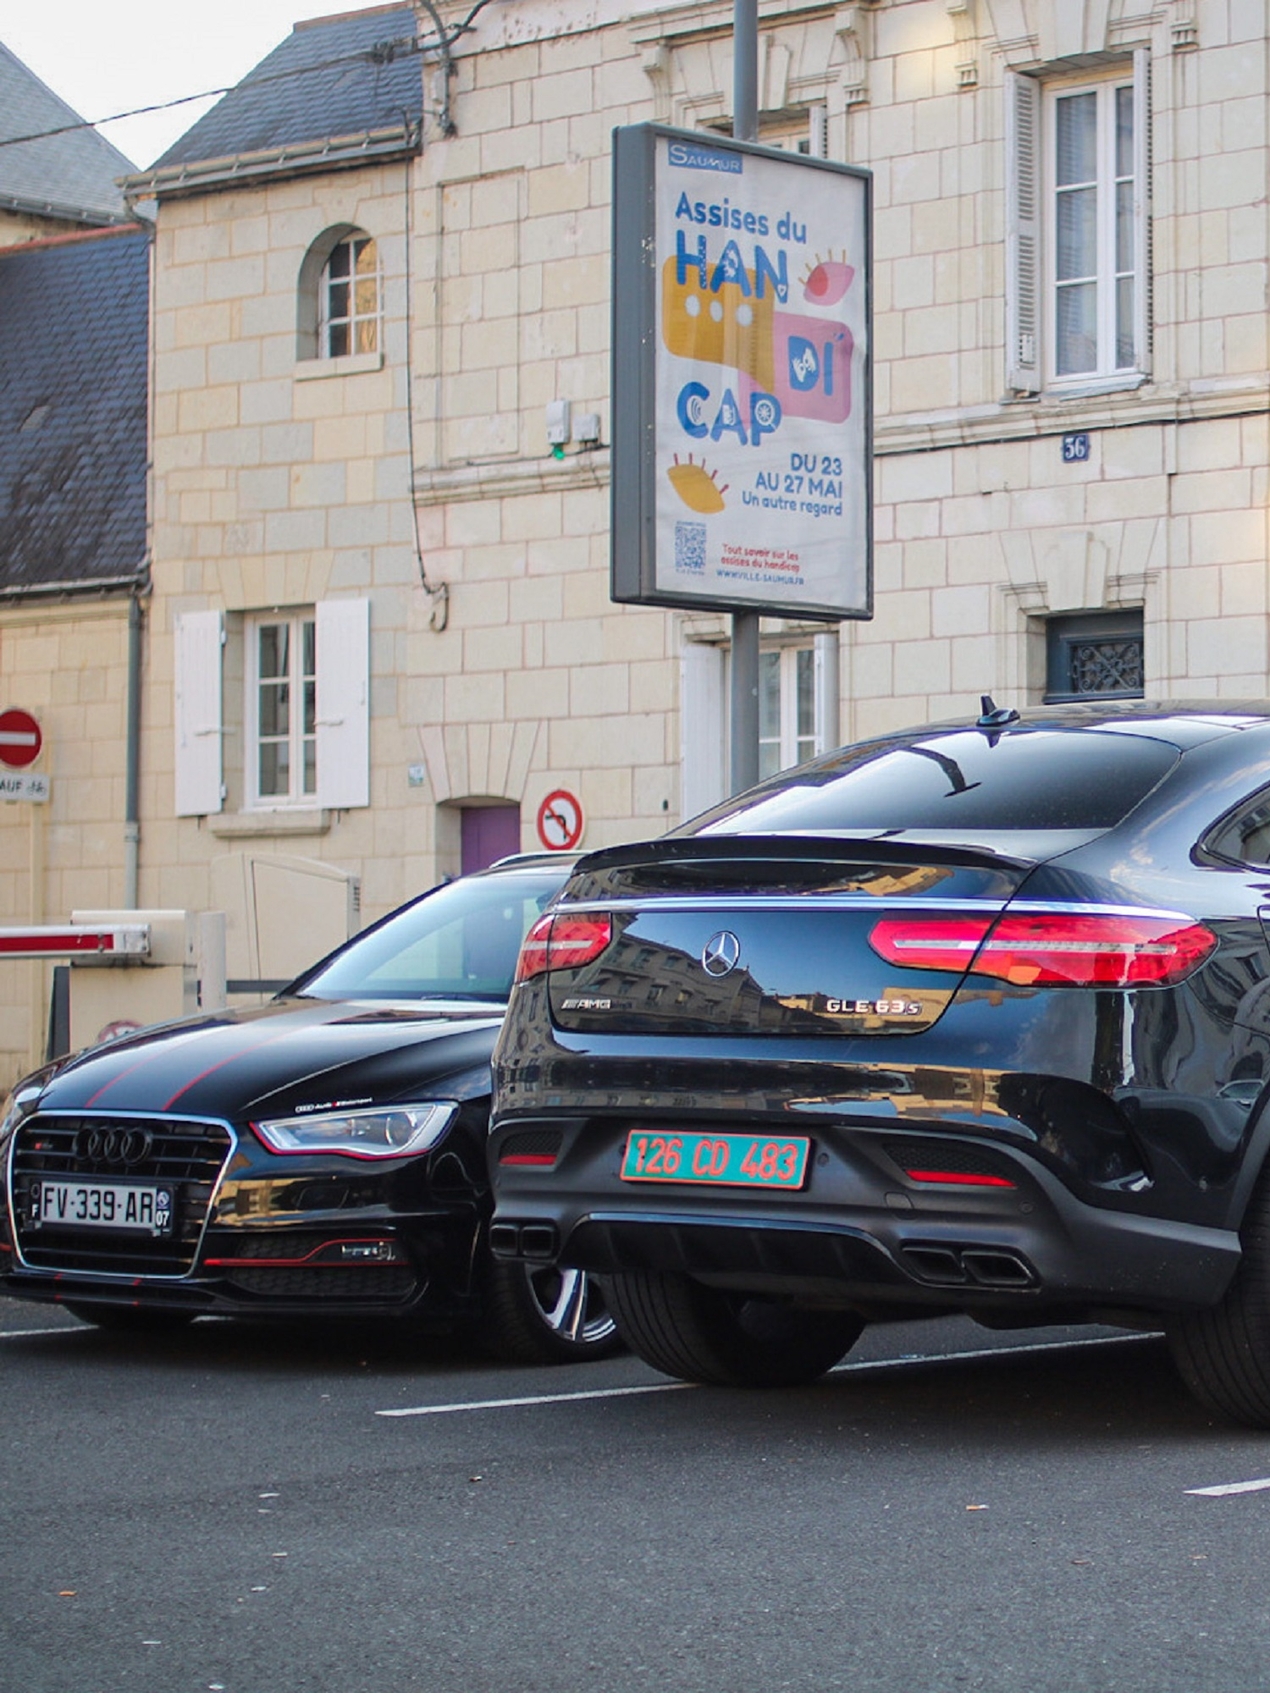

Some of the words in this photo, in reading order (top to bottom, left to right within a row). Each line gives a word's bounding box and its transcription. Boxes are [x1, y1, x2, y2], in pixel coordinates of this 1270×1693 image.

[675, 192, 769, 236] Assises
[776, 211, 807, 244] du
[676, 229, 789, 304] HAN
[788, 335, 834, 396] DI
[677, 381, 783, 447] CAP
[1065, 436, 1086, 460] 36
[790, 453, 817, 474] DU
[821, 456, 843, 476] 23
[755, 471, 780, 492] AU
[784, 475, 804, 494] 27
[808, 478, 842, 499] MAI
[742, 491, 759, 507] Un
[762, 494, 797, 512] autre
[800, 500, 843, 518] regard
[722, 543, 742, 555] Tout
[744, 547, 770, 557] savoir
[772, 550, 785, 559] sur
[787, 550, 799, 561] les
[752, 557, 763, 569] du
[826, 998, 870, 1013] GLE
[635, 1137, 684, 1175] 126
[692, 1139, 730, 1177] CD
[740, 1142, 798, 1181] 483
[31, 1203, 39, 1218] F
[155, 1210, 170, 1227] 07
